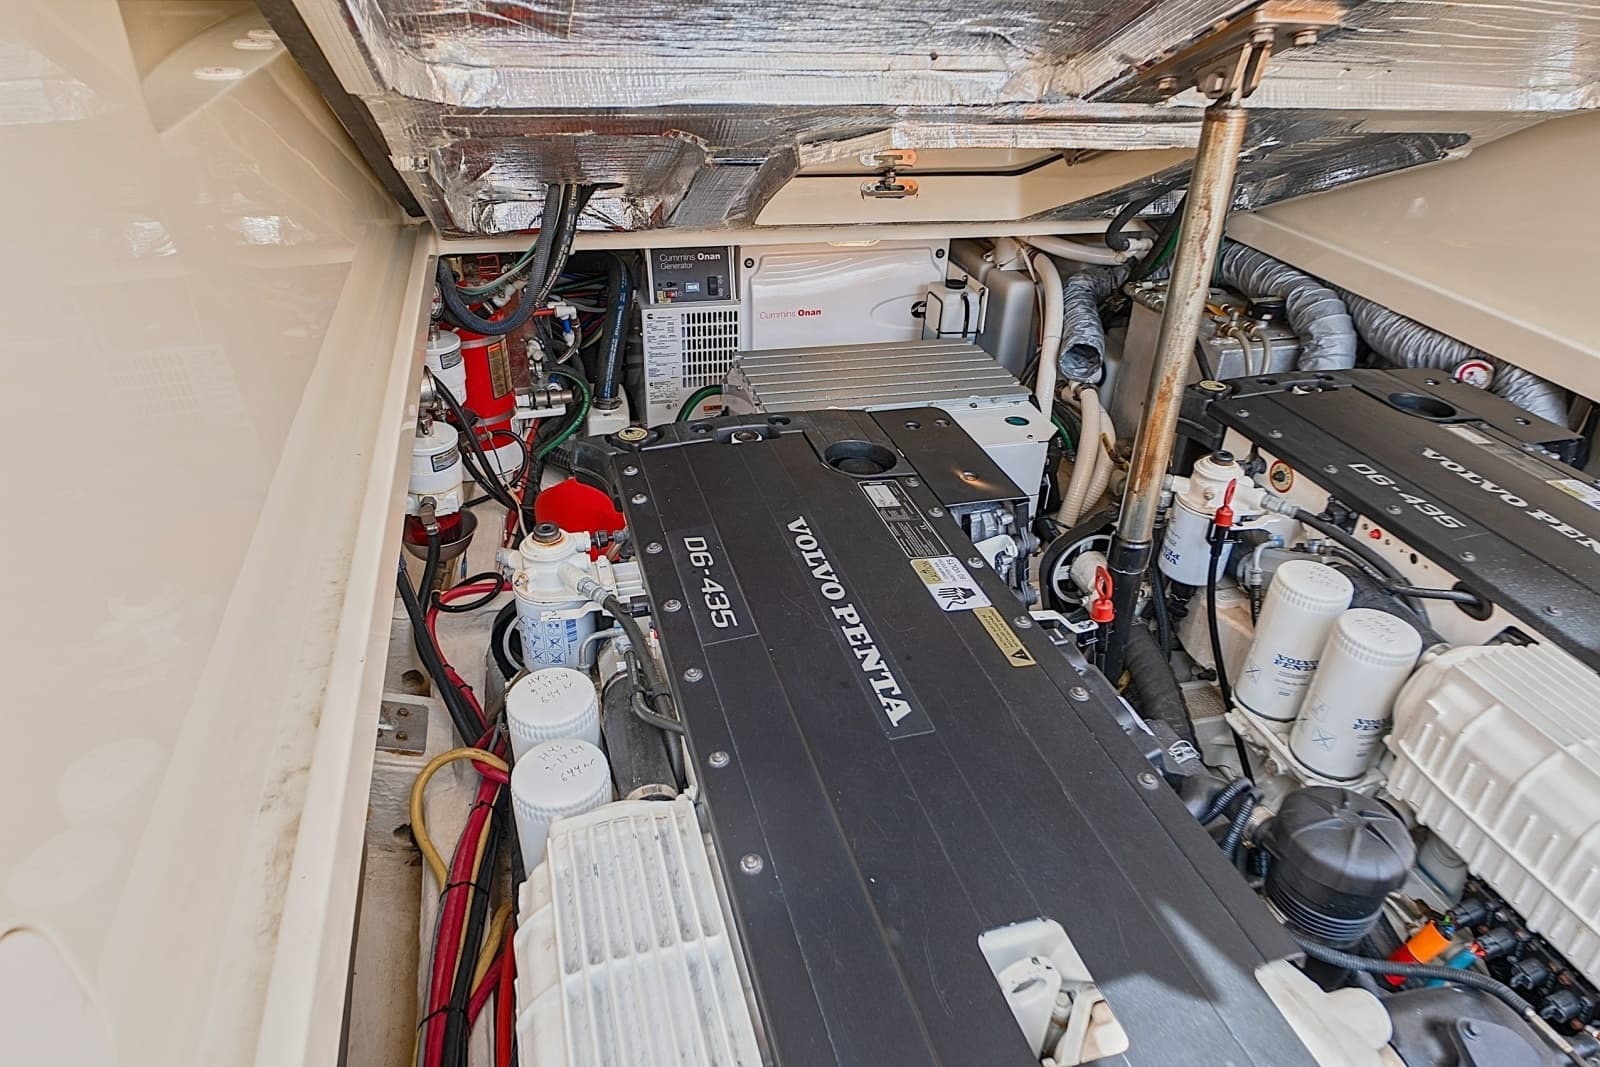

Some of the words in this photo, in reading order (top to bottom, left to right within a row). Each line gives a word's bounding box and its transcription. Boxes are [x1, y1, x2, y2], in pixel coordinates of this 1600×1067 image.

[659, 253, 696, 262] Cummins
[697, 252, 721, 261] Onan
[660, 262, 693, 270] Generator
[759, 311, 796, 320] Cummins
[797, 309, 822, 317] Onan
[1347, 463, 1467, 528] D6-435
[1420, 447, 1529, 508] VOLVO
[683, 536, 739, 628] D6-435
[920, 560, 942, 582] CAUTION
[786, 516, 846, 601] VOLVO
[831, 603, 913, 728] PENTA
